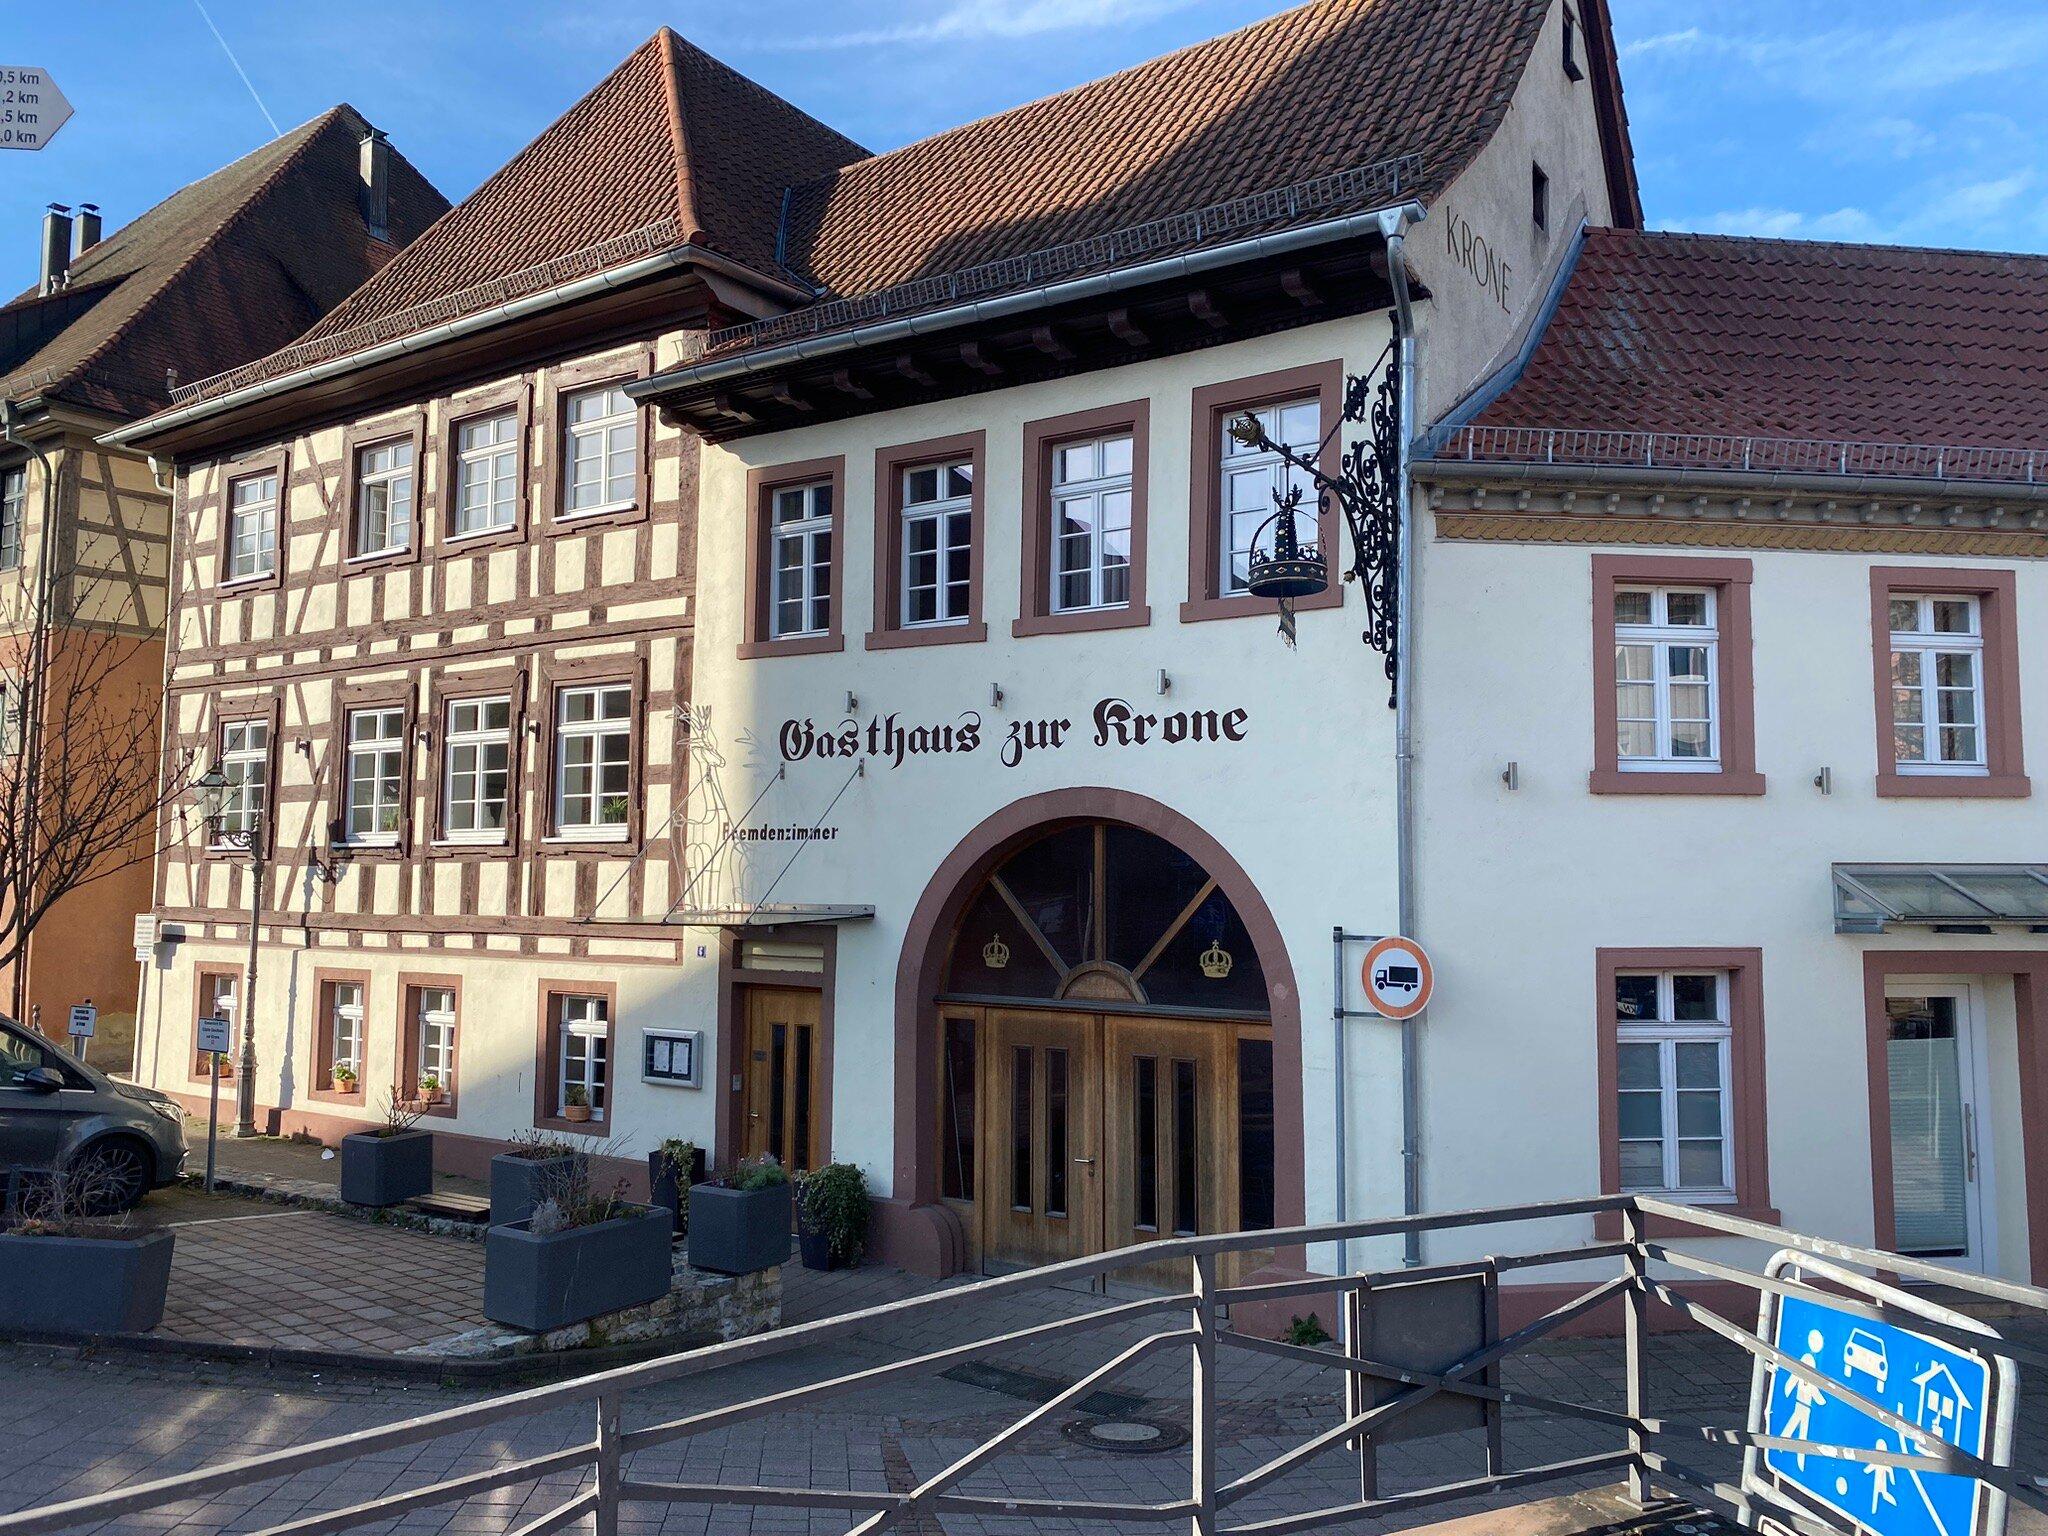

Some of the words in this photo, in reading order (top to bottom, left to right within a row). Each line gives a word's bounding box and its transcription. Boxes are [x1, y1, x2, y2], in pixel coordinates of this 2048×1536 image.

[20, 71, 39, 84] km
[19, 91, 39, 104] km
[17, 110, 38, 124] km
[16, 130, 37, 143] km
[1446, 205, 1512, 315] KRONE
[779, 709, 982, 770] Gasthaus
[1000, 716, 1071, 768] zur
[1093, 697, 1249, 748] Krone
[722, 822, 839, 841] Fremdenzimmer
